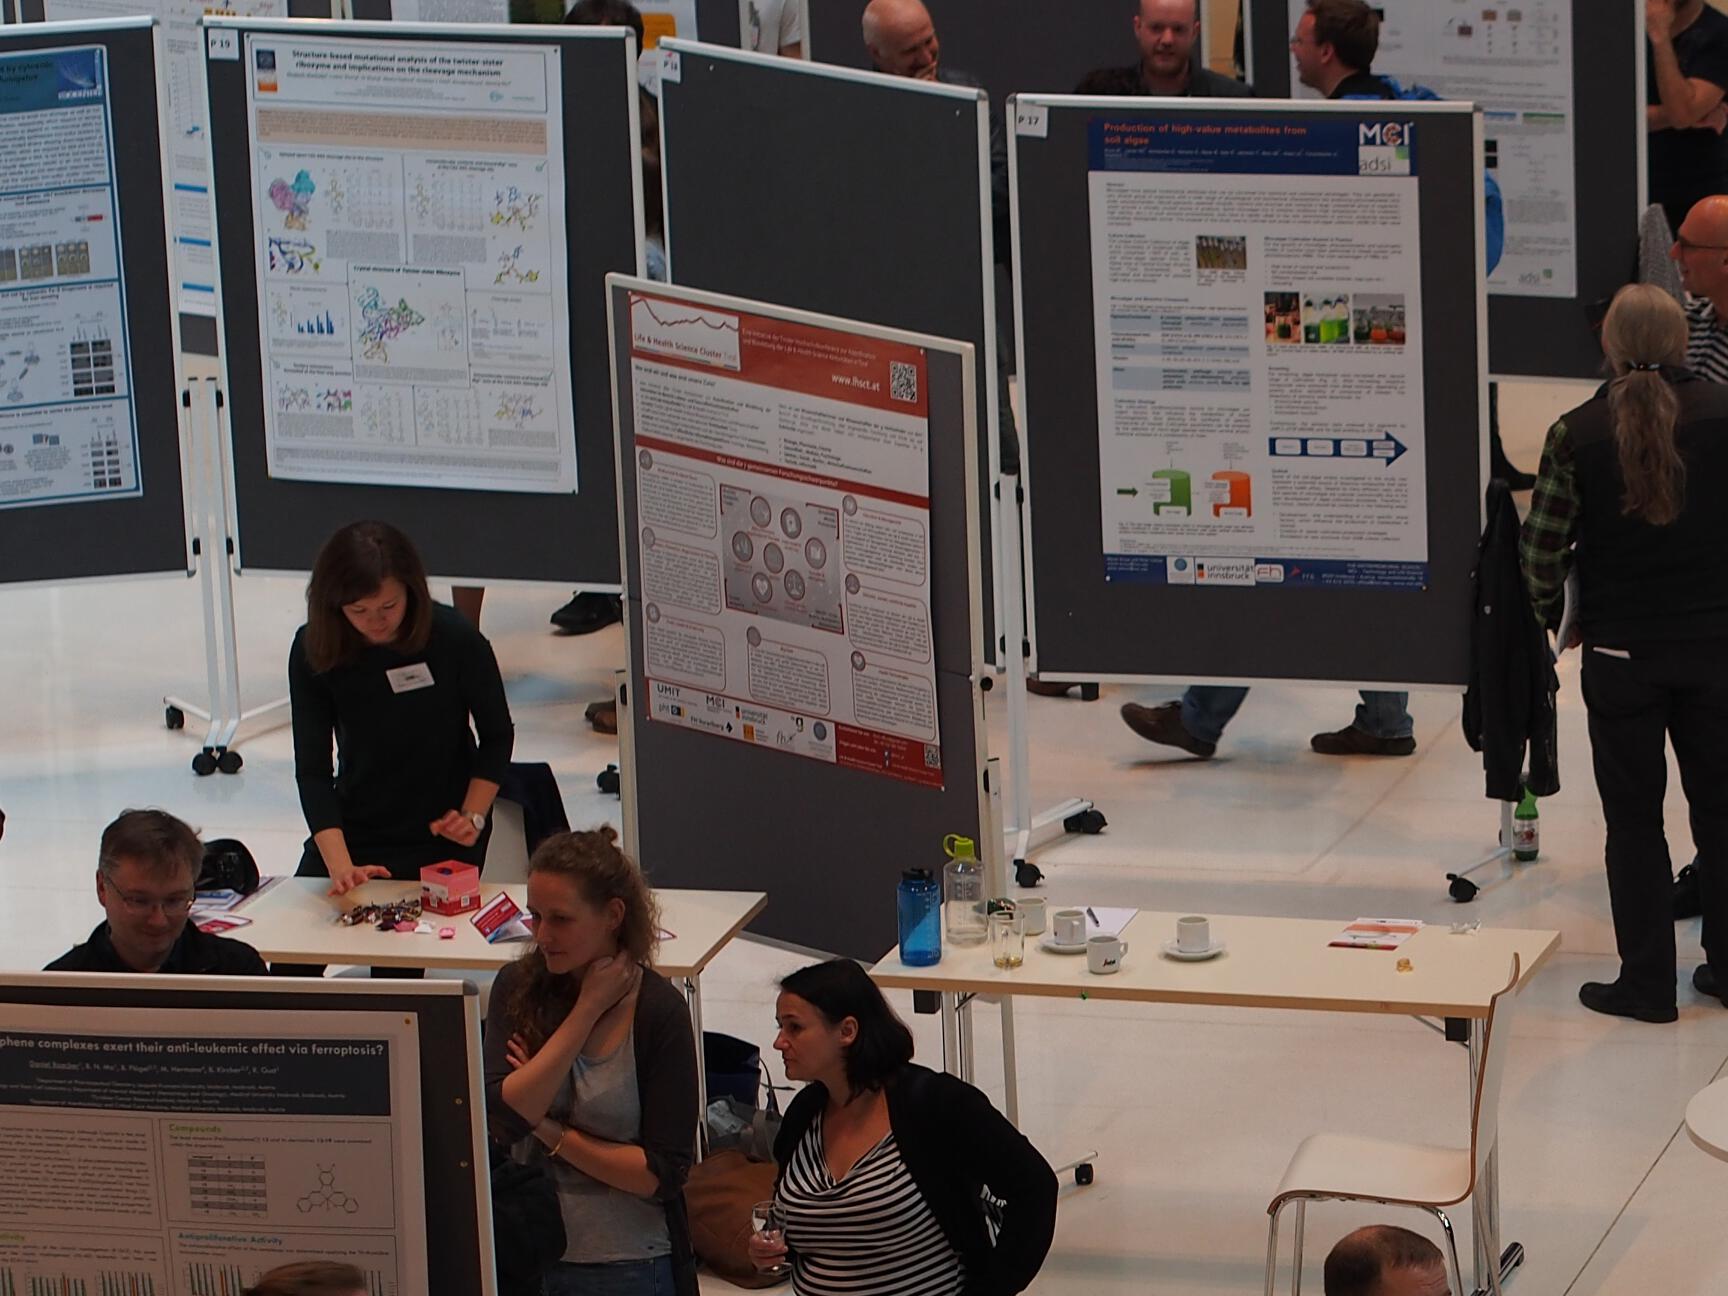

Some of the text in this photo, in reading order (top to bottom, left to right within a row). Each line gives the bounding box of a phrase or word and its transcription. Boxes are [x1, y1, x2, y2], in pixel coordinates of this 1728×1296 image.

[210, 40, 230, 48] P 19
[354, 53, 395, 64] mutational
[397, 54, 427, 67] analysis
[429, 55, 438, 65] of
[439, 56, 451, 66] the
[327, 62, 347, 72] and
[396, 66, 407, 74] on
[408, 65, 420, 75] the
[422, 66, 454, 78] cleavage
[456, 67, 501, 78] mechanism
[1018, 115, 1039, 126] P 17
[1104, 123, 1306, 137] Production of high-value metabolites from
[1104, 136, 1149, 148] soil algae
[1359, 154, 1391, 173] adsi
[647, 336, 652, 344] &
[674, 341, 698, 354] Science
[700, 346, 722, 358] Cluster
[1207, 563, 1254, 572] universität
[1208, 571, 1249, 579] innsbruck
[656, 684, 680, 698] UMIT
[38, 1040, 100, 1054] complexes
[103, 1042, 133, 1054] exert
[136, 1042, 164, 1054] their
[166, 1043, 250, 1055] anti-leukemic
[252, 1044, 286, 1055] effect
[288, 1044, 308, 1055] via
[312, 1044, 384, 1058] ferroptosis?
[169, 1122, 222, 1135] Compounds
[250, 1235, 283, 1247] Activity
